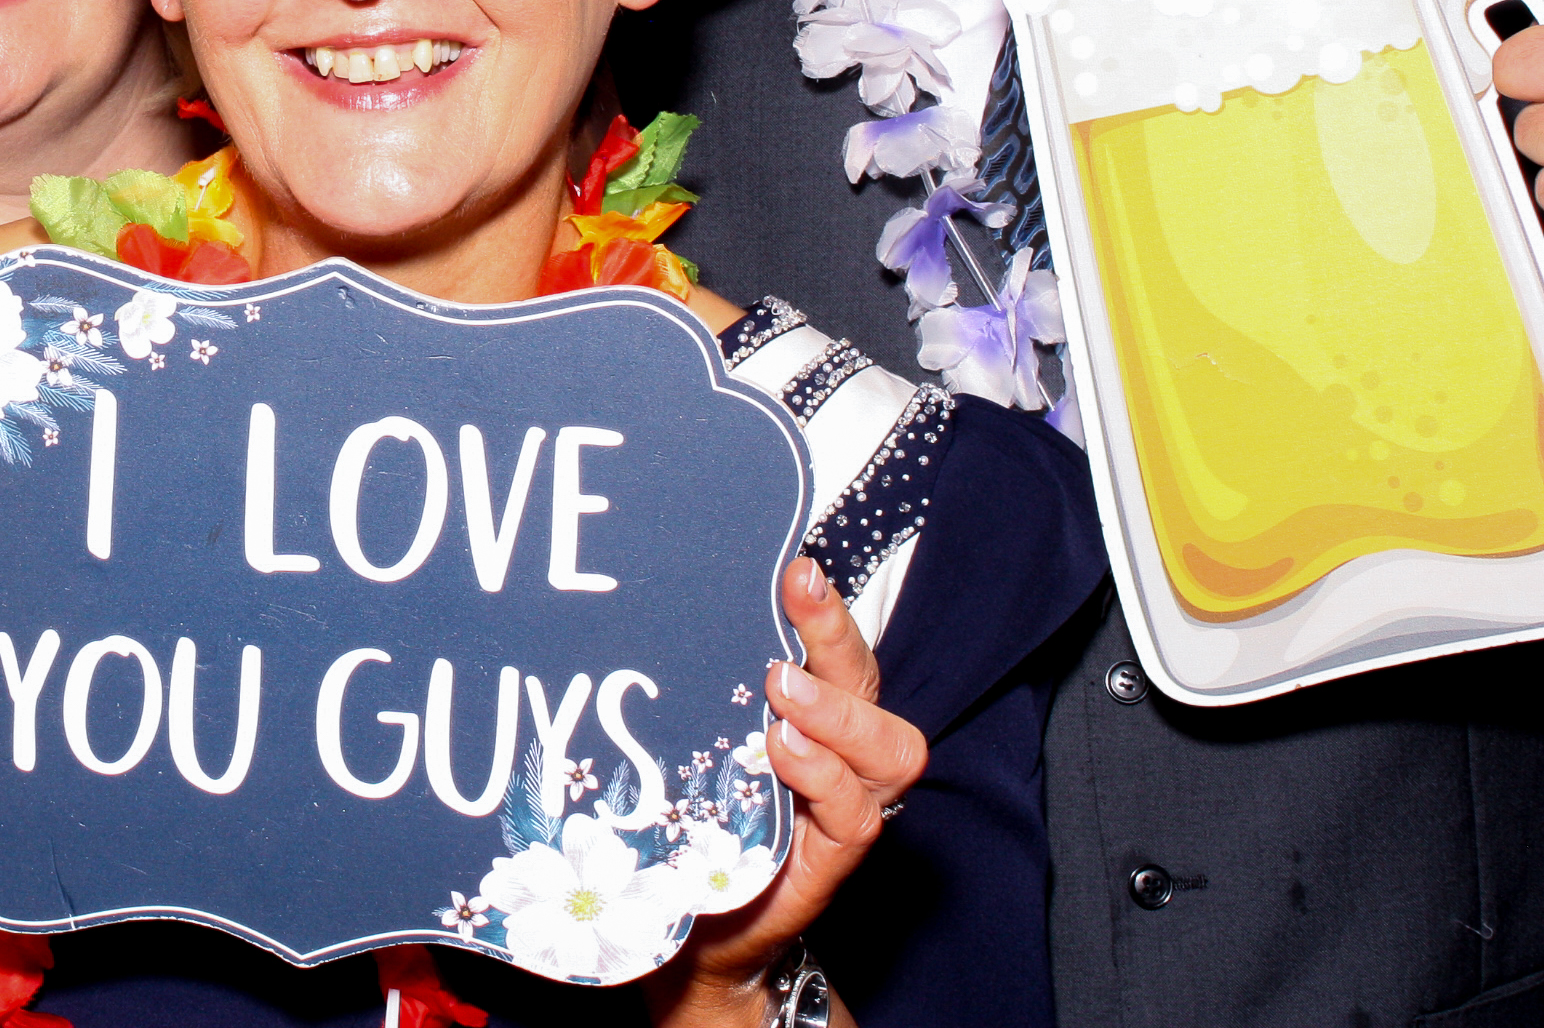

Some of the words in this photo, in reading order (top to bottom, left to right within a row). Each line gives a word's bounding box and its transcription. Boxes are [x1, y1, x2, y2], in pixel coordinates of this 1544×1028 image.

[86, 388, 117, 560] I
[244, 402, 624, 592] LOVE
[315, 647, 659, 831] GUYS
